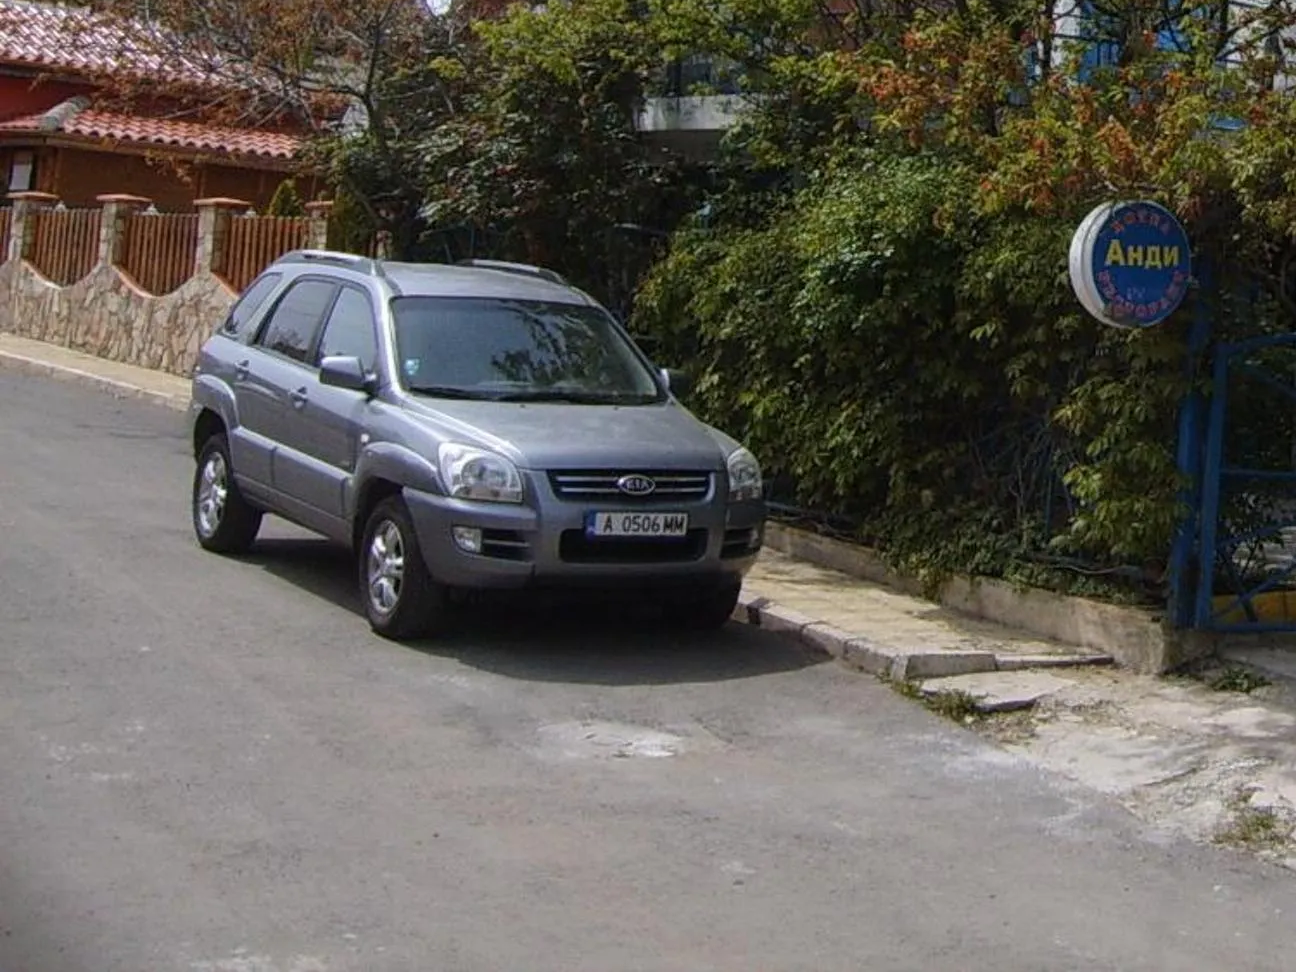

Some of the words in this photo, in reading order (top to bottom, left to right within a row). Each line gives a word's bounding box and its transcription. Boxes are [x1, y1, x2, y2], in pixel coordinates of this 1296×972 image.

[1104, 239, 1180, 270] Анди
[626, 478, 650, 490] KIA
[603, 515, 614, 532] A
[622, 515, 661, 533] 0506
[664, 515, 686, 533] MM
